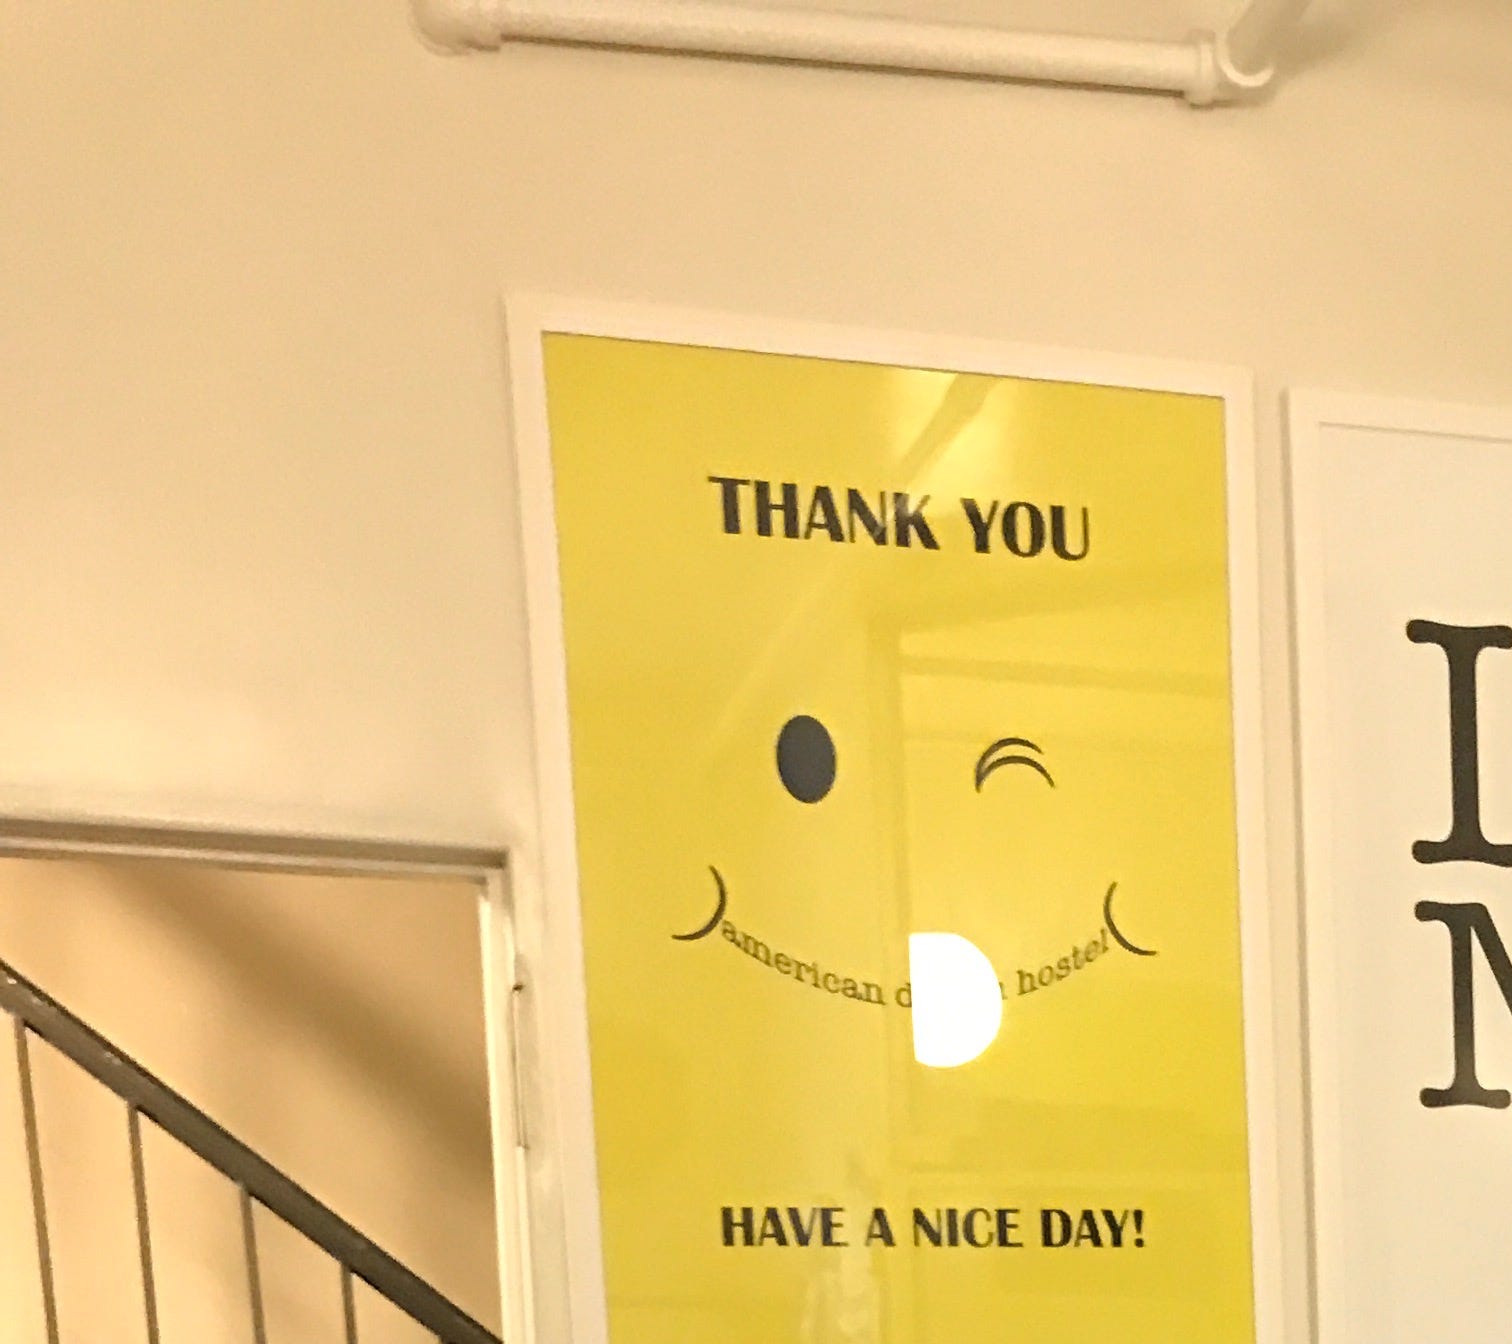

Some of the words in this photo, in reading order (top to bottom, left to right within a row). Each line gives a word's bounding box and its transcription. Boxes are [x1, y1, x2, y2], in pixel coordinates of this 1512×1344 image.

[707, 475, 941, 551] THANK
[960, 497, 1092, 562] YOU
[721, 918, 887, 1007] american
[1016, 928, 1110, 997] hostel
[721, 1205, 849, 1249] HAVE
[864, 1206, 896, 1248] A
[911, 1206, 1024, 1249] NICE
[1040, 1208, 1146, 1249] DAY!
